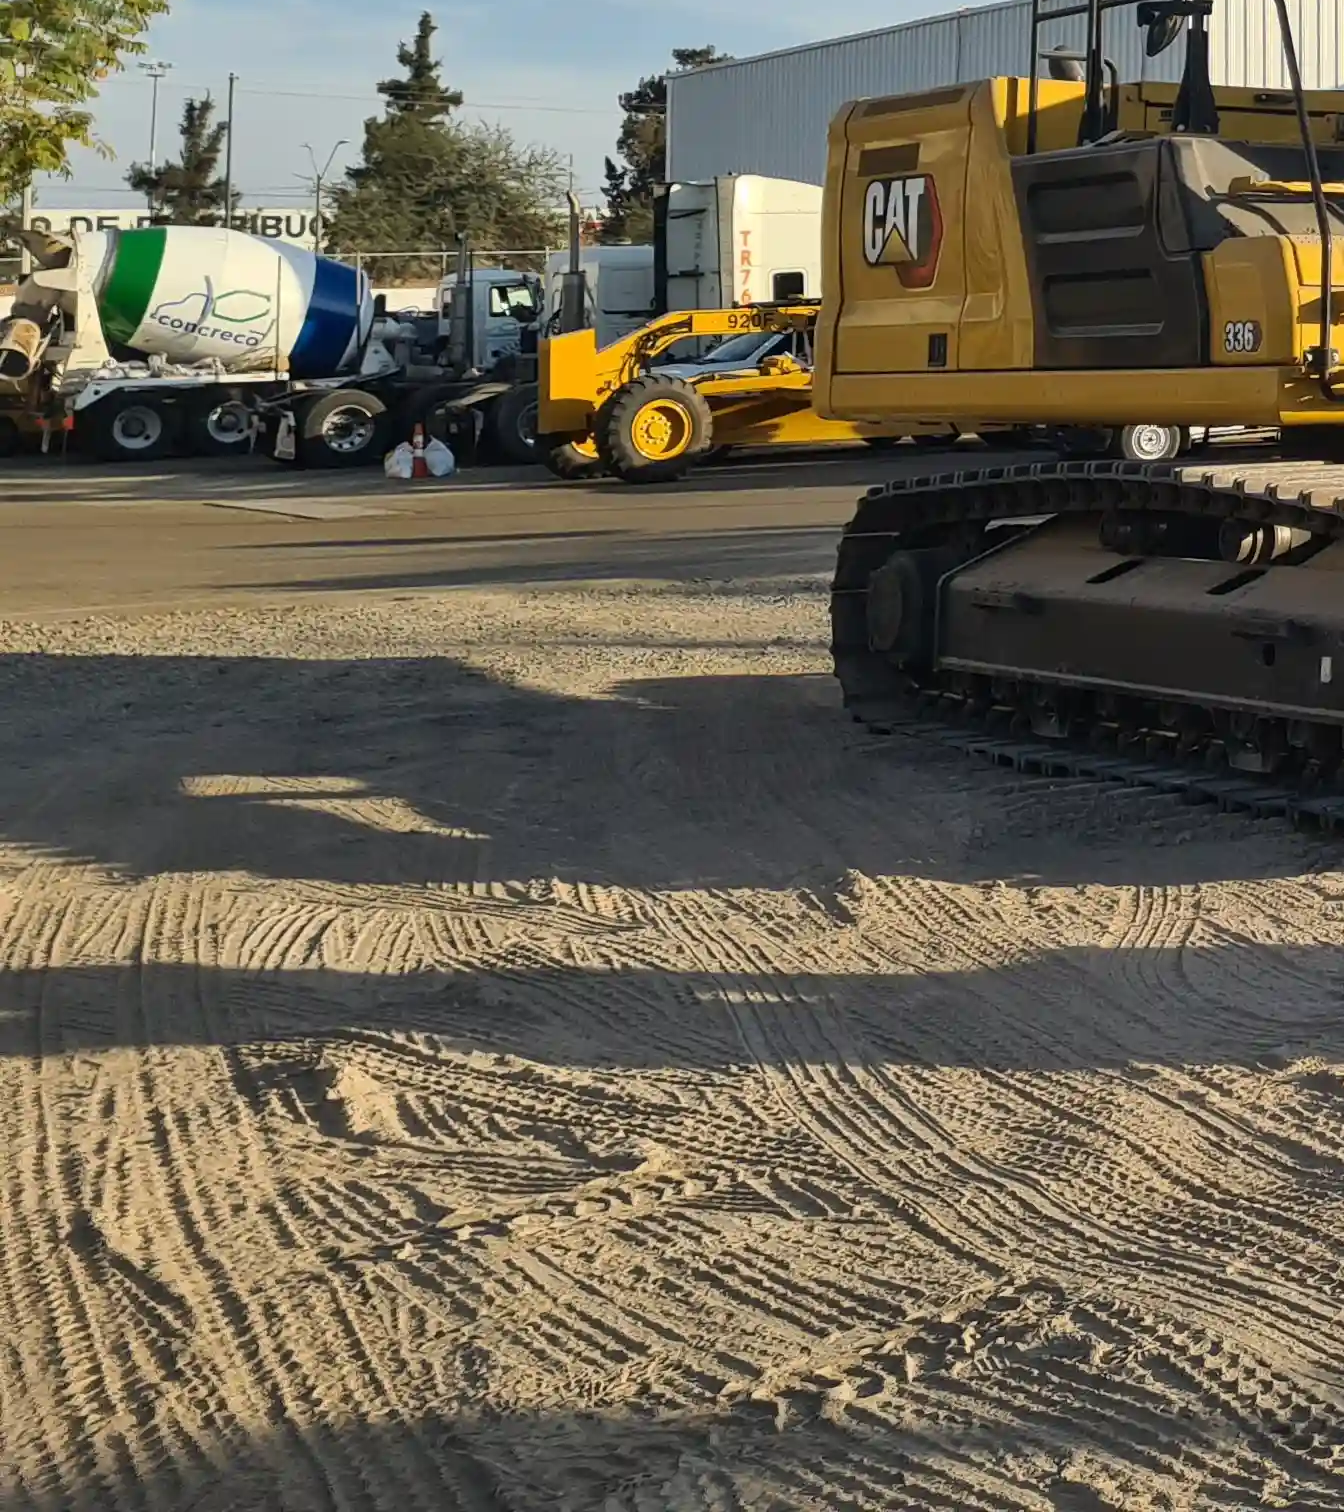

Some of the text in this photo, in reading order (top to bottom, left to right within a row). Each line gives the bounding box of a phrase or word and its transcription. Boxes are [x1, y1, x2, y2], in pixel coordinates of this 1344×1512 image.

[71, 216, 118, 232] DE
[863, 177, 926, 265] CAT
[158, 315, 259, 347] concreco
[728, 314, 775, 329] 920F
[1225, 322, 1254, 351] 336
